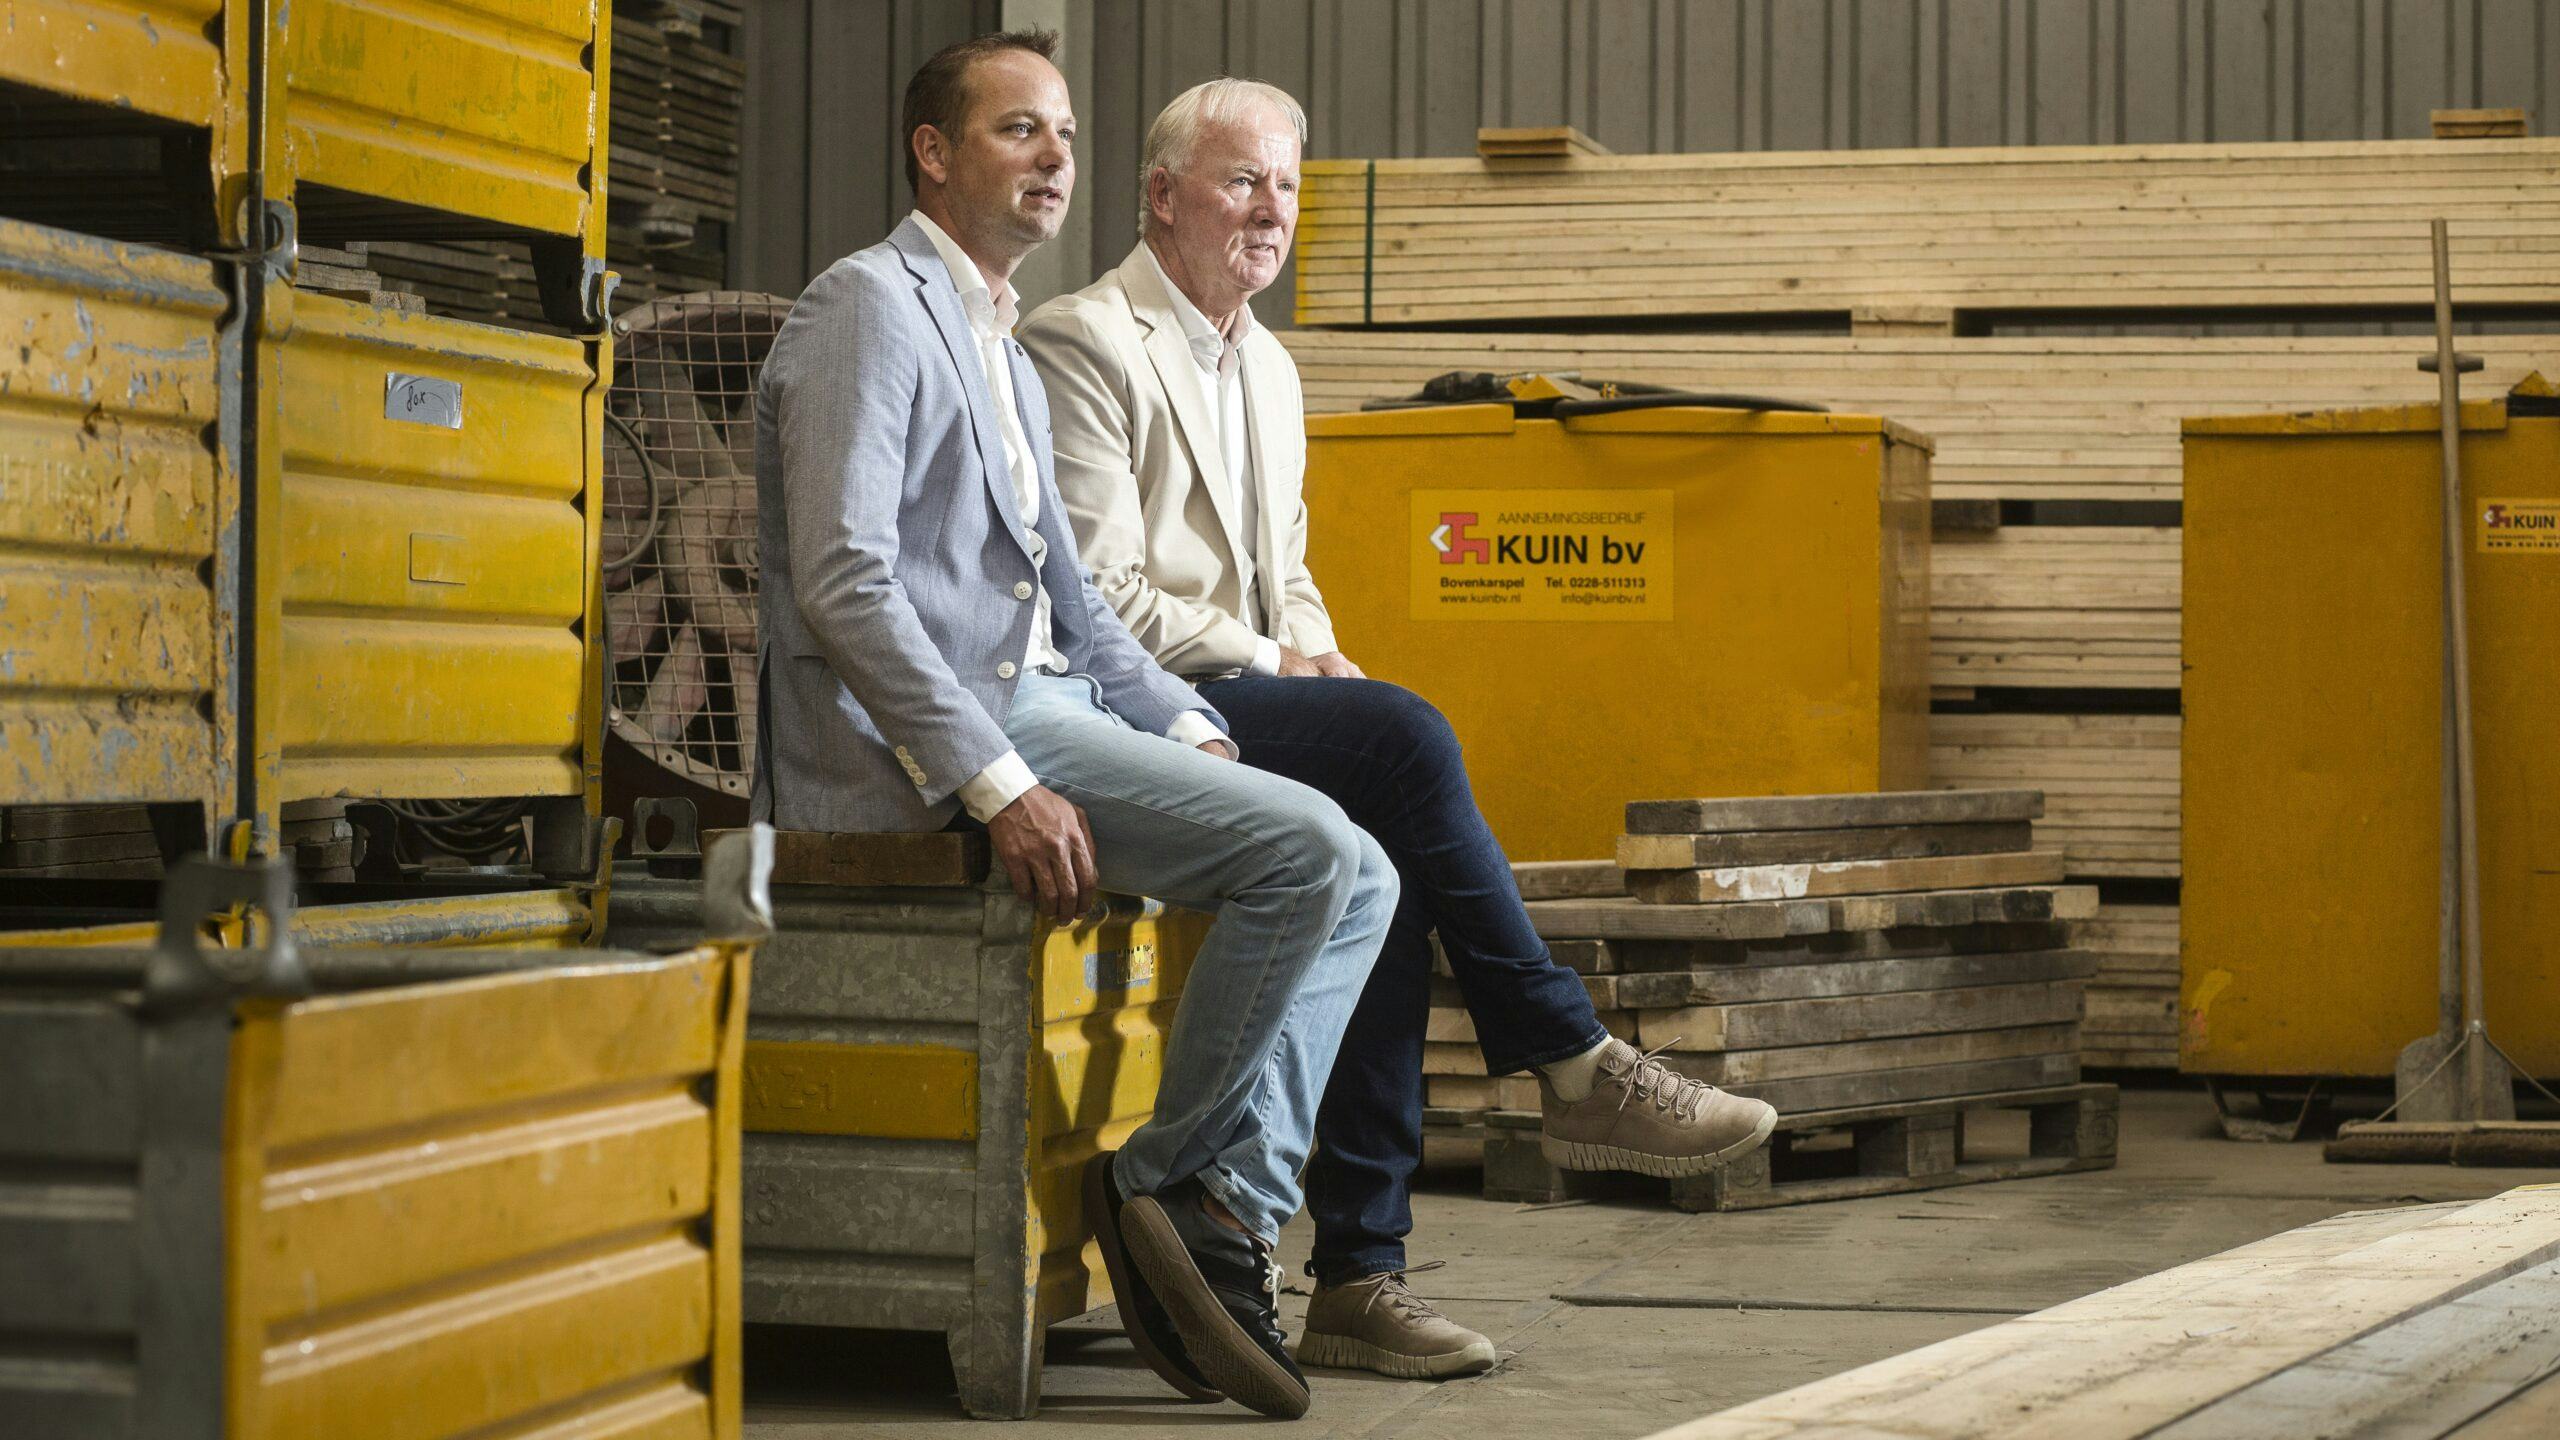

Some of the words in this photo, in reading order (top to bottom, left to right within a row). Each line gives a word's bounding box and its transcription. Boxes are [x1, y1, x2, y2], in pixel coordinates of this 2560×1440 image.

[1497, 512, 1646, 525] AANNEMINGSBEDRIJF
[2514, 515, 2555, 529] KUIN
[1497, 535, 1588, 564] KUIN
[1602, 535, 1646, 564] bv
[1440, 577, 1524, 590] Bovenkarspel
[1545, 577, 1565, 588] Tel.
[1569, 577, 1646, 588] 0228-511313
[1440, 593, 1521, 605] www.kuinbv.nl
[1561, 593, 1646, 606] info@kuinbv.nl
